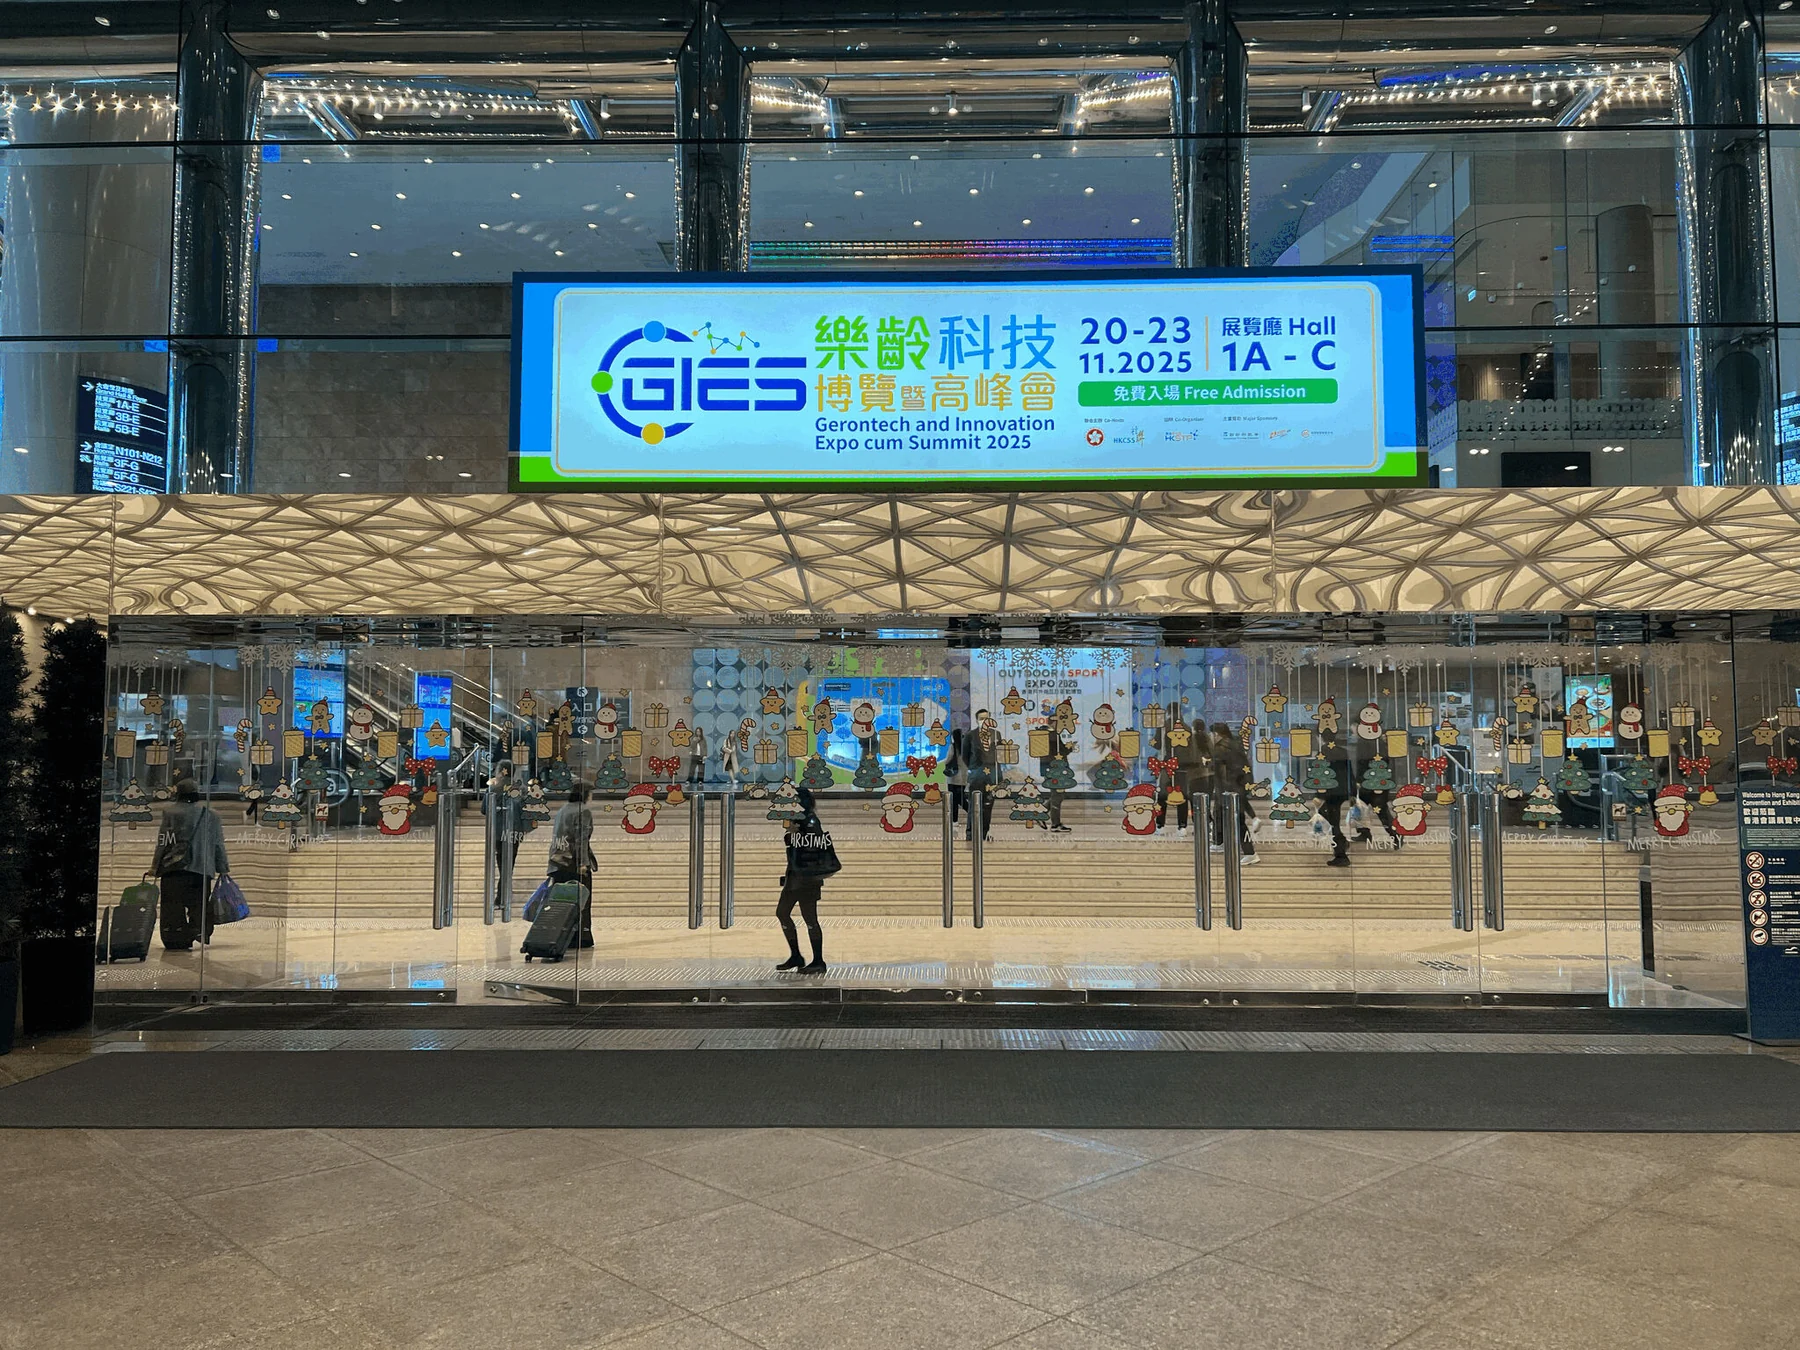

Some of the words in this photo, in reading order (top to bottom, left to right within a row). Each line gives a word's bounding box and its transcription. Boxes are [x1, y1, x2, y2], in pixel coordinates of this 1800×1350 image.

[1080, 316, 1191, 344] 20-23
[1222, 317, 1282, 336] 展覽廳
[1289, 316, 1336, 335] Hall
[814, 314, 1056, 370] 樂齡科技
[1079, 351, 1191, 374] 11.2025
[1222, 341, 1271, 372] 1A
[1311, 340, 1336, 371] C
[622, 357, 807, 411] GIES
[814, 372, 1056, 412] 博覽暨高峰會
[1113, 385, 1180, 402] 免費入場
[1184, 386, 1218, 399] Free
[1223, 384, 1306, 399] Admission
[115, 399, 140, 412] 1A-E
[115, 412, 140, 425] 3B-E
[815, 416, 910, 432] Gerontech
[916, 416, 949, 432] and
[955, 415, 1055, 431] Innovation
[114, 424, 140, 437] 5B-E
[815, 435, 859, 453] Expo
[864, 438, 903, 450] cum
[908, 434, 981, 450] Summit
[987, 435, 1031, 449] 2025
[114, 458, 139, 471] 3F-G
[115, 446, 163, 465] N101-N212
[113, 471, 139, 483] 5F-G
[1068, 669, 1104, 678] SPORT
[1025, 680, 1055, 688] EXPO
[1627, 834, 1664, 851] MERRY
